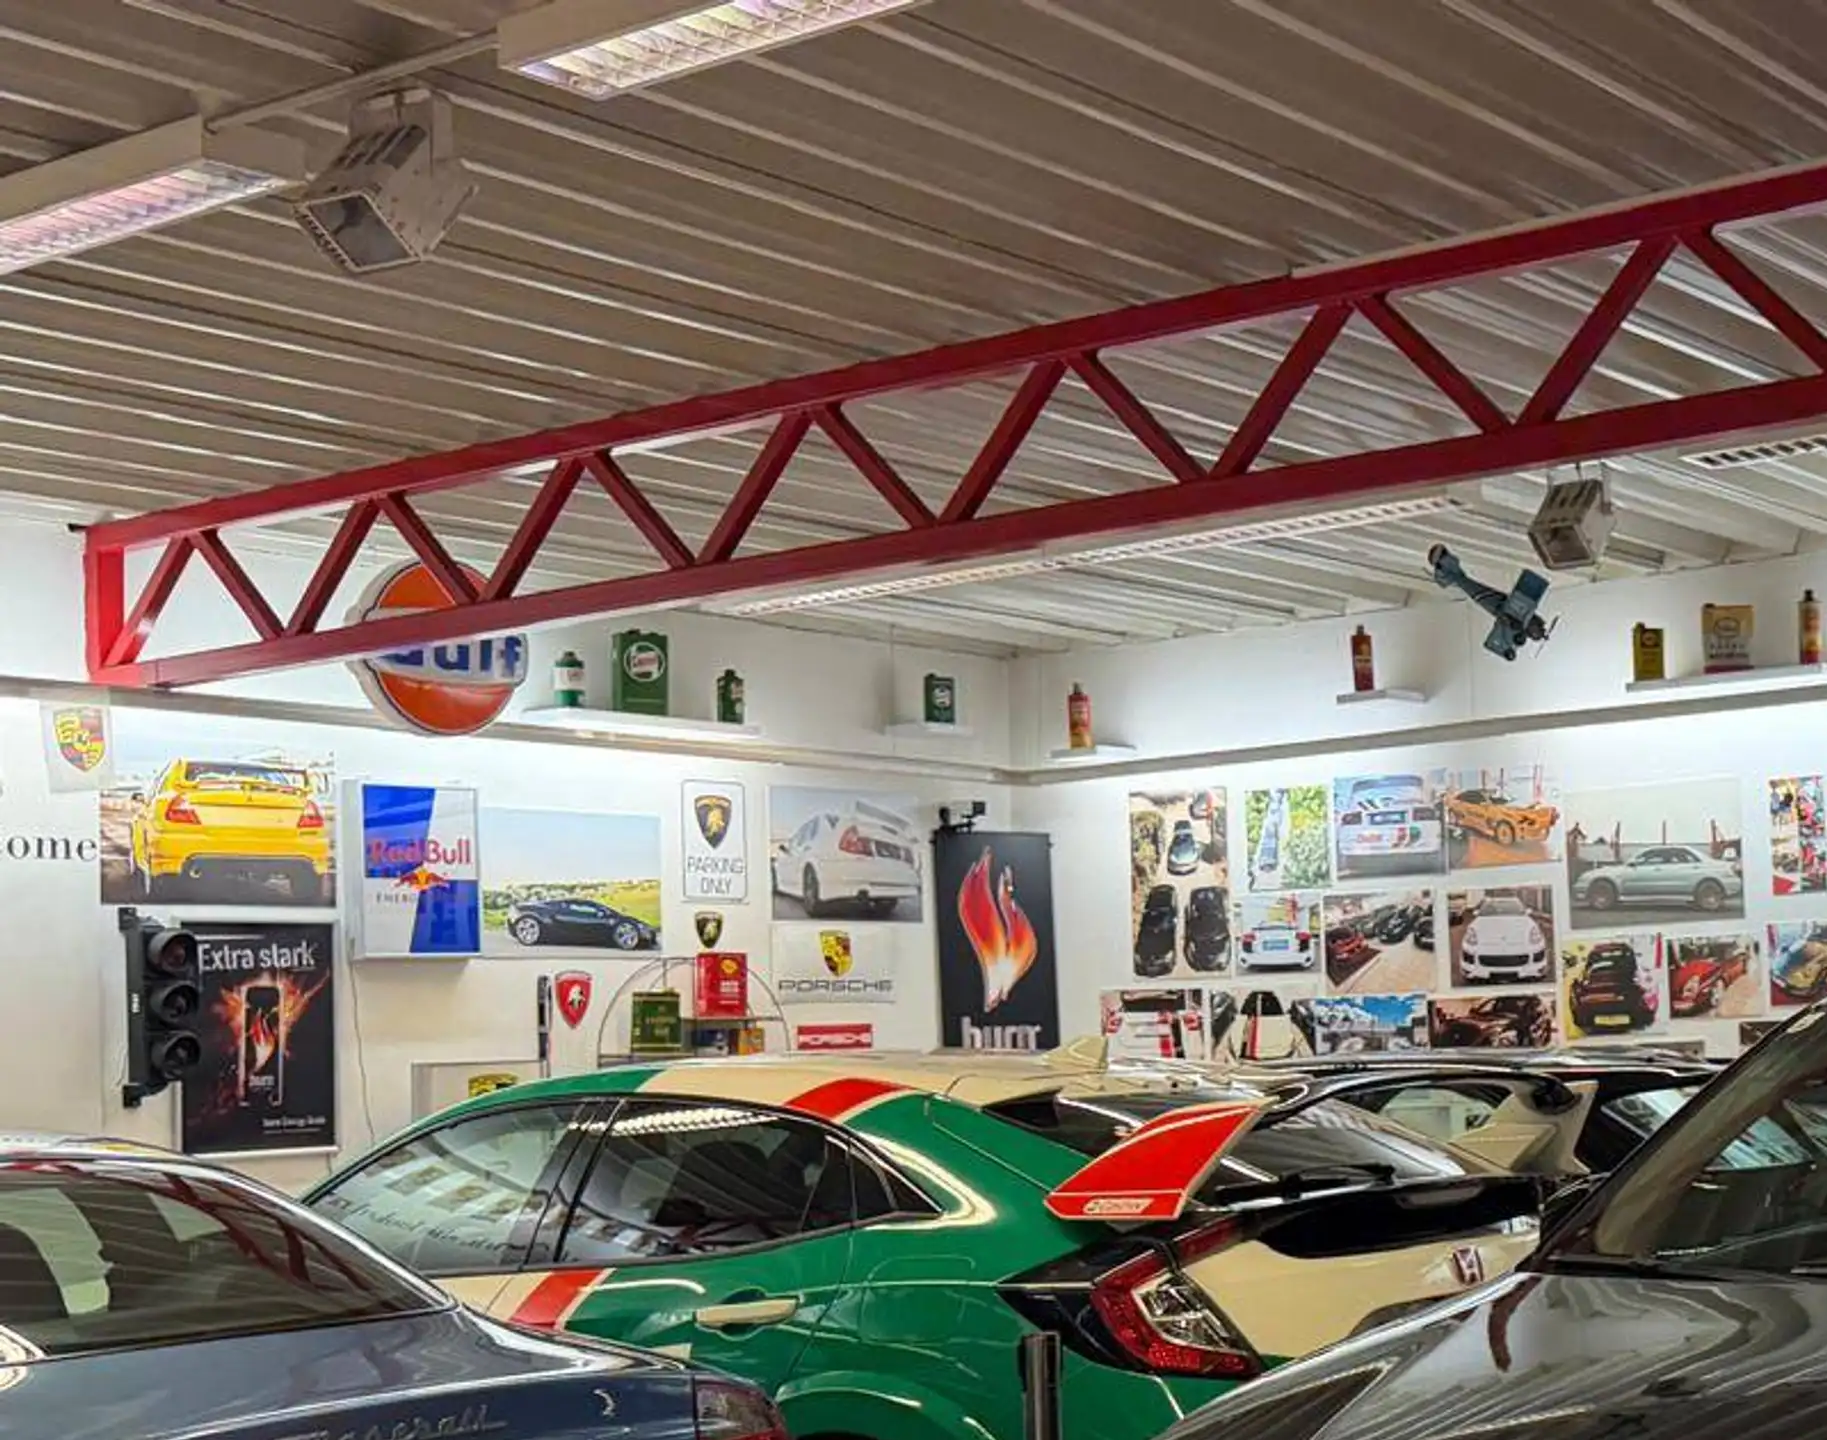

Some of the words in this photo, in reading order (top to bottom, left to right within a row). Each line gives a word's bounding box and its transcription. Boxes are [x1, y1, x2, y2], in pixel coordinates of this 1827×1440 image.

[0, 836, 98, 862] ome
[371, 840, 424, 863] Red
[426, 837, 472, 864] Bull
[686, 856, 745, 875] PARKING
[701, 877, 733, 895] ONLY
[198, 943, 255, 971] Extra
[260, 940, 316, 968] stark
[778, 979, 893, 994] PORSCHE
